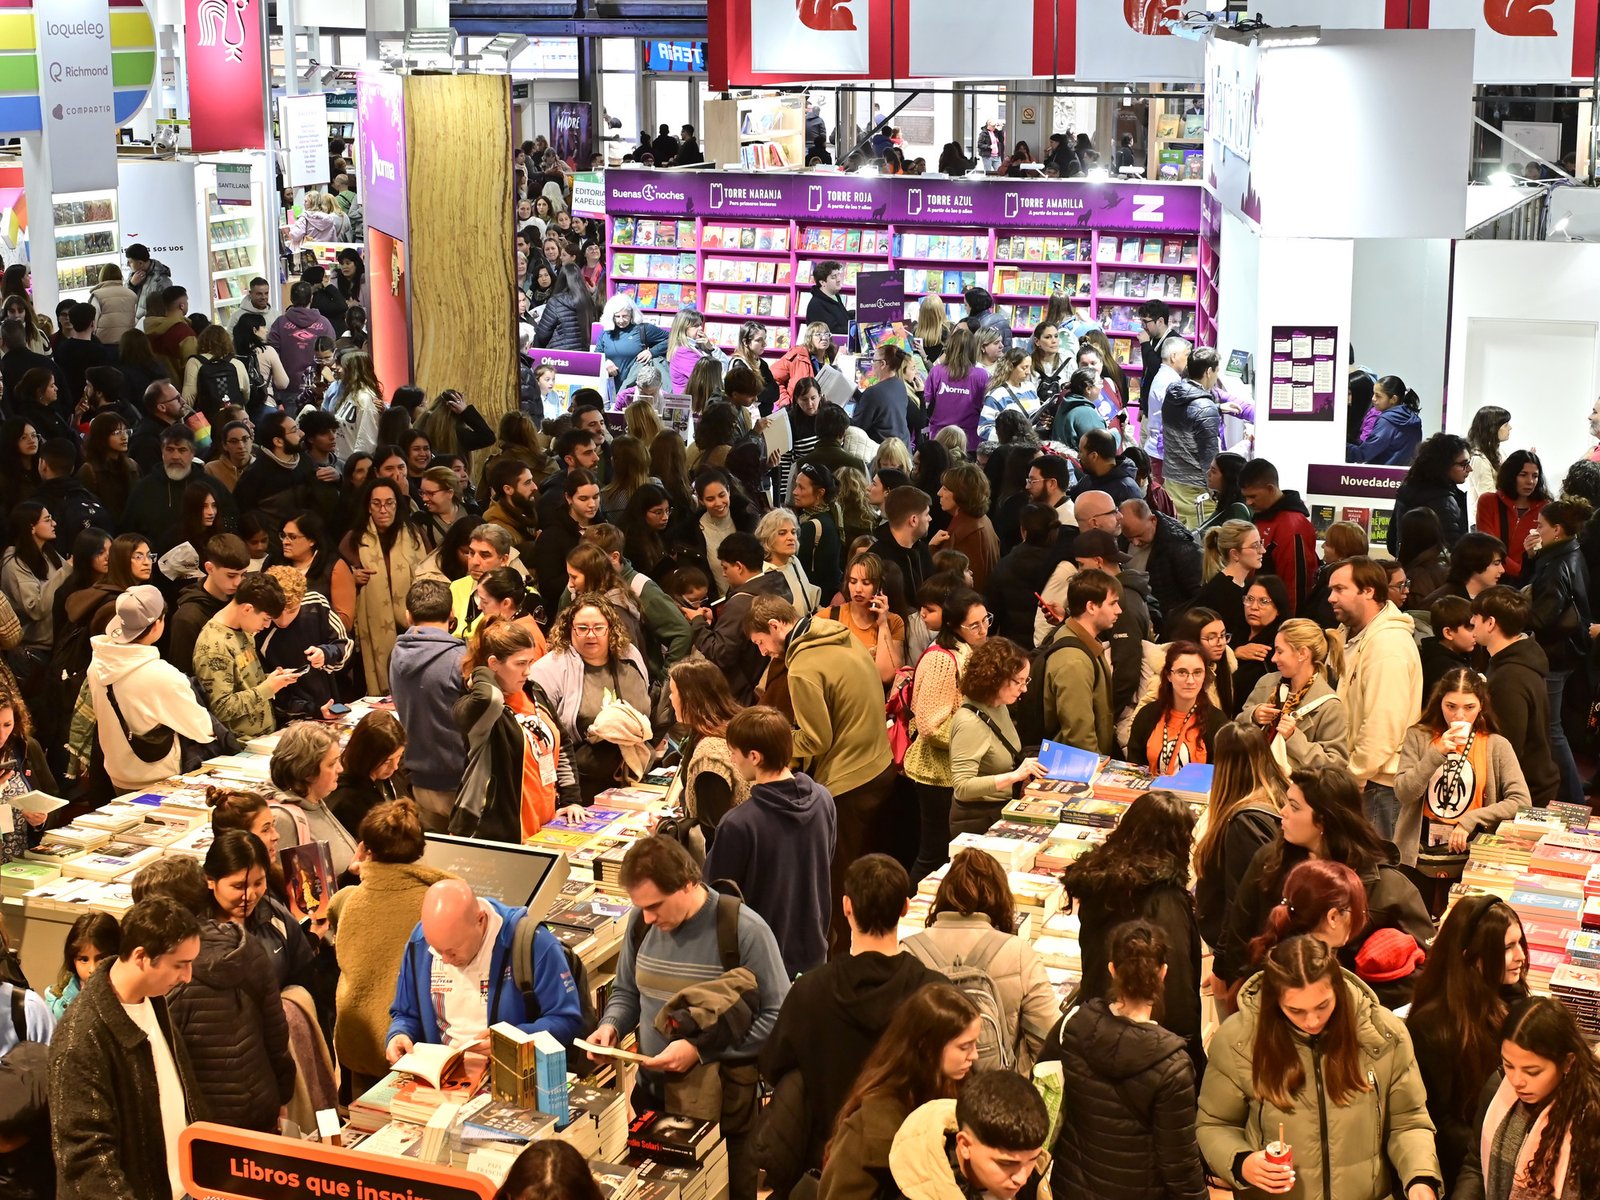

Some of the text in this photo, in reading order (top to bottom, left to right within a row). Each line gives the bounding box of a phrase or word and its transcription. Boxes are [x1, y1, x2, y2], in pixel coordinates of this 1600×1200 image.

[46, 20, 104, 39] loqueleo
[66, 65, 108, 77] Richmond
[66, 105, 110, 115] COMPARTIR
[556, 116, 580, 130] MADRE
[371, 140, 395, 185] Norma
[218, 182, 250, 190] SANTILLANA
[612, 189, 684, 200] Buenas noches
[724, 188, 782, 200] TORRE NARANJA
[827, 190, 872, 203] TORRE ROJA
[927, 194, 973, 206] TORRE AZUL
[1020, 197, 1083, 209] TORRE AMARILLA
[541, 357, 569, 366] Ofertas
[938, 382, 970, 394] Norma
[1340, 475, 1402, 488] Novedades
[230, 1158, 431, 1200] Libros que inspi
